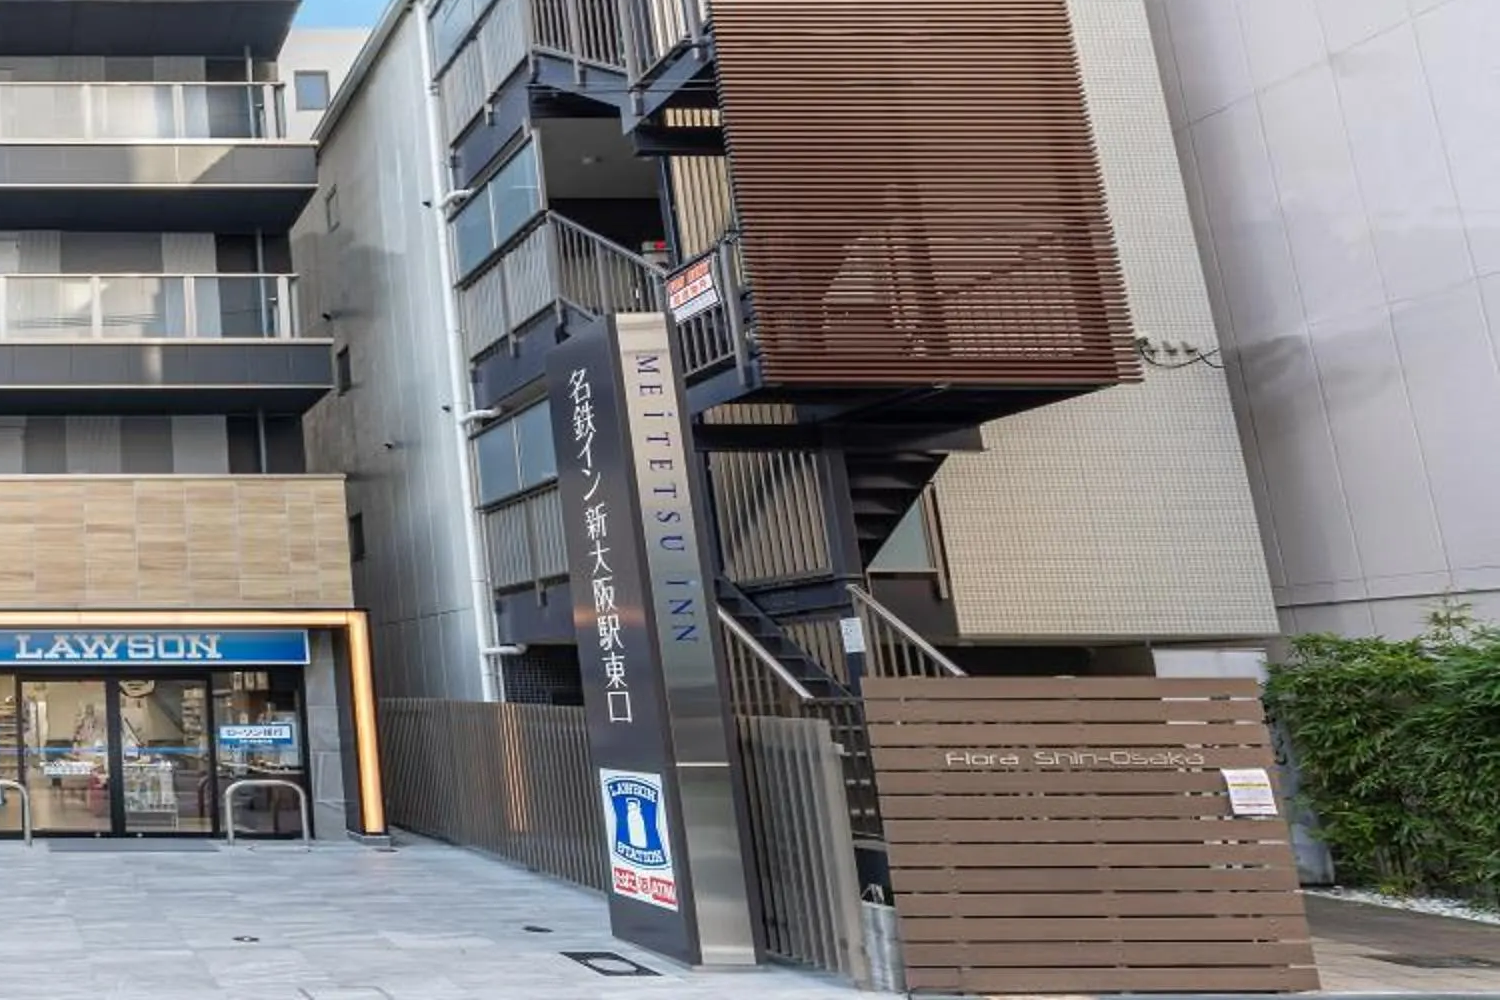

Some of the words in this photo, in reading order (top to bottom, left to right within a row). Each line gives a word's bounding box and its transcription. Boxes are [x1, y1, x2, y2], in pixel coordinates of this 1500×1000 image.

[15, 634, 223, 659] LAWSON
[944, 751, 1020, 767] Flora
[1034, 751, 1206, 767] Shin-Osaka
